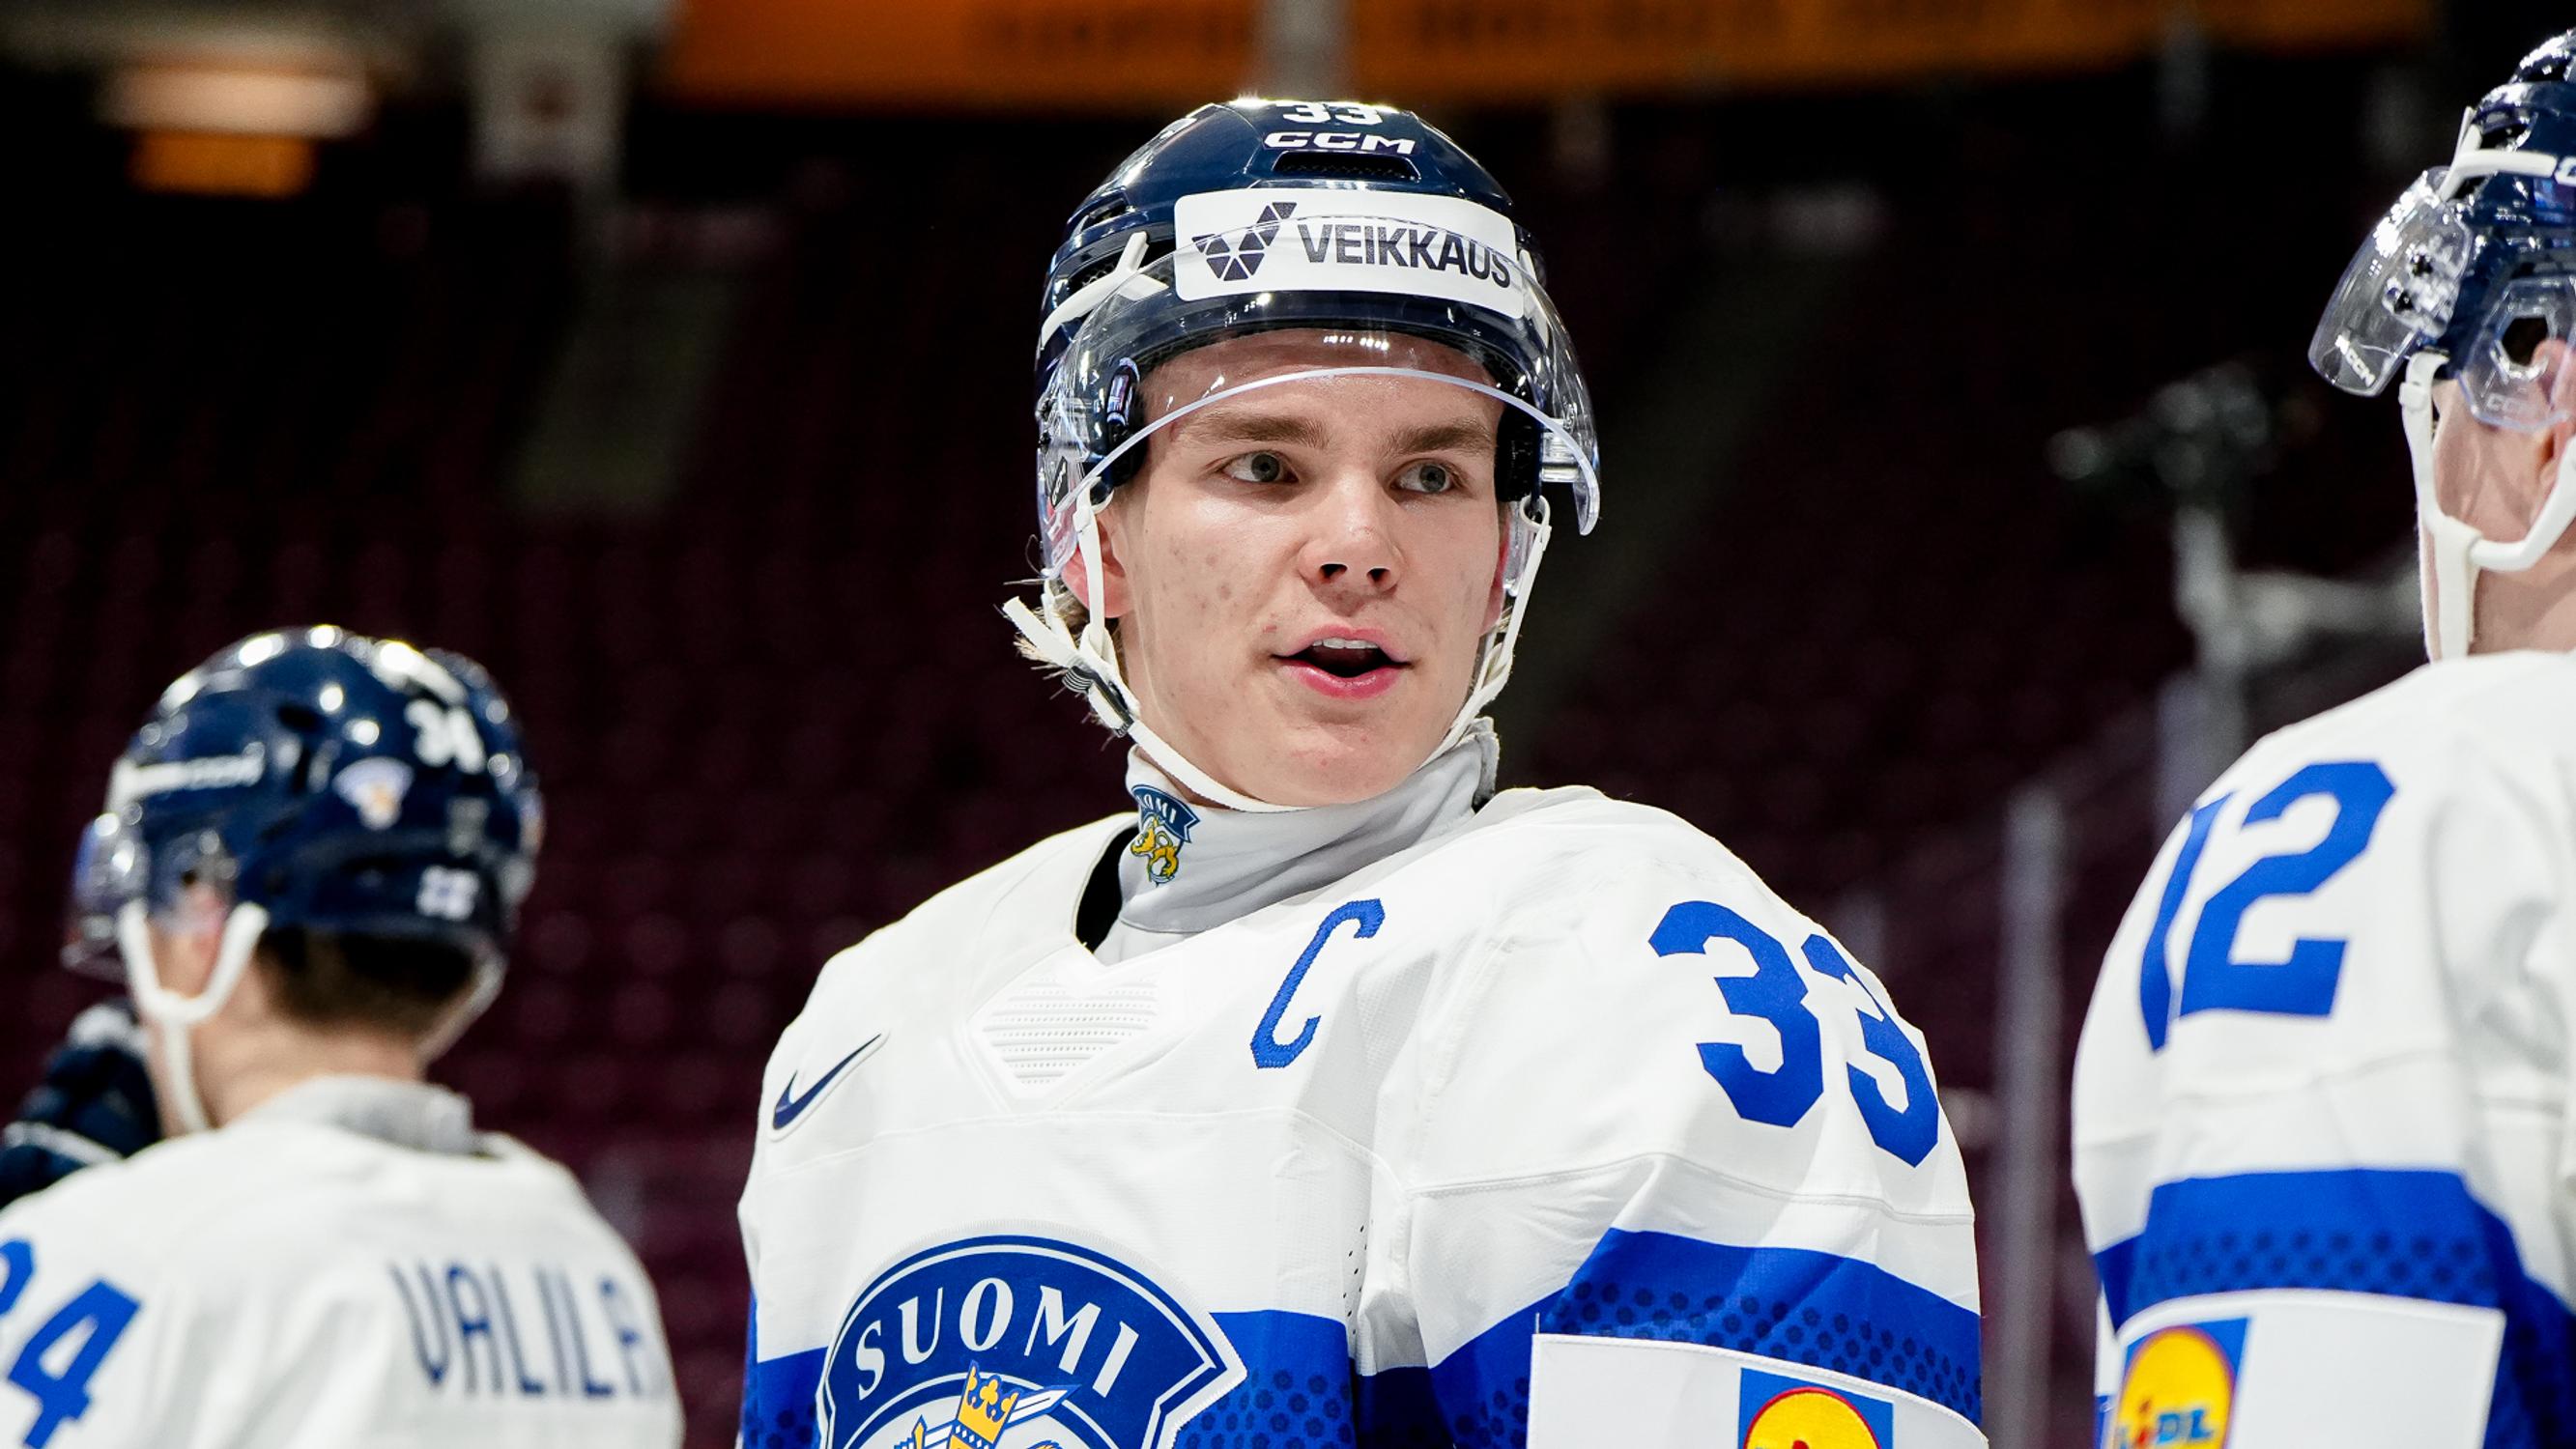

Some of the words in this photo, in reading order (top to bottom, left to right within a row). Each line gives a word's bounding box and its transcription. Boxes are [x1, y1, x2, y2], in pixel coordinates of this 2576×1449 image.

[1264, 131, 1416, 155] CCM
[1275, 100, 1384, 126] 33
[1297, 223, 1511, 289] VEIKKAUS
[2139, 761, 2396, 1058] 12
[1249, 898, 1386, 1068] C
[1647, 900, 1939, 1168] 33
[855, 1277, 1139, 1400] SUOMI
